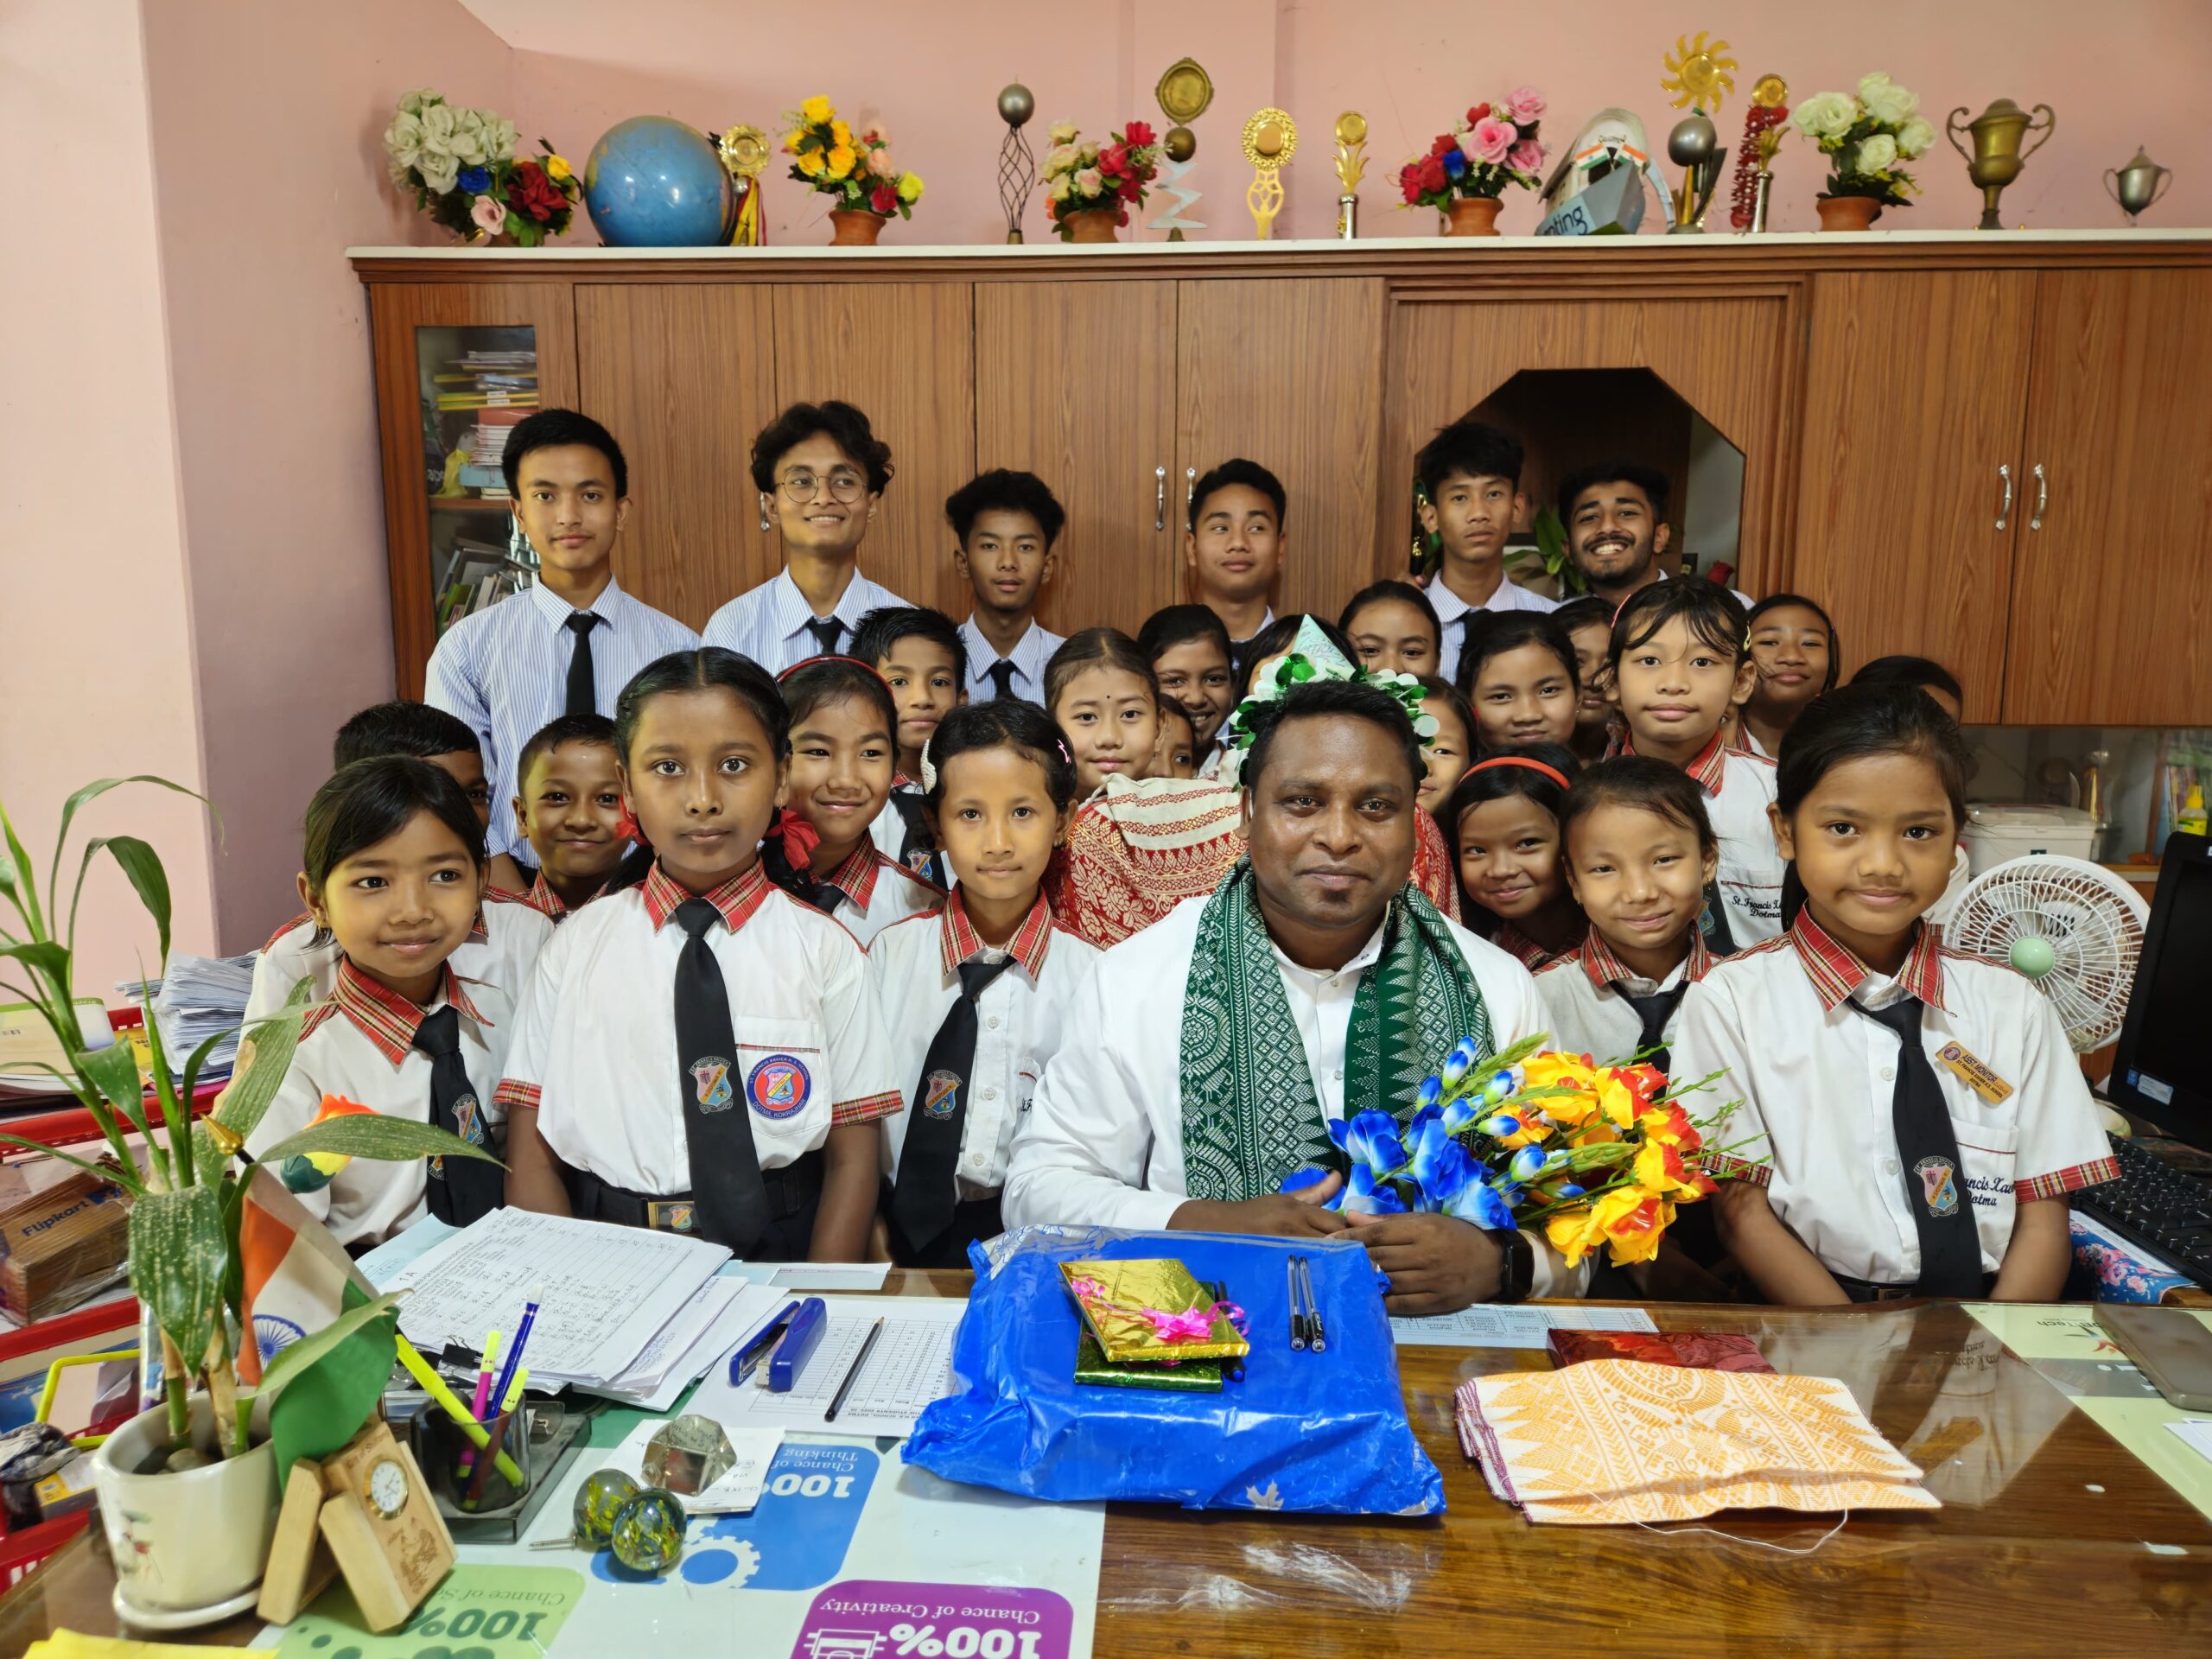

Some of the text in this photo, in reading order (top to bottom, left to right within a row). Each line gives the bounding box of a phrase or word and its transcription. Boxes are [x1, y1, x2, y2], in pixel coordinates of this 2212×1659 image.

[1745, 899, 1771, 910] Francis
[1750, 908, 1781, 918] Dotma
[751, 1059, 769, 1077] FRANCIS
[1974, 1064, 1997, 1083] MONITOR
[773, 1098, 806, 1118] KOKRAJHAR
[22, 1200, 90, 1236] Flipkart
[783, 1449, 858, 1462] Thinking
[771, 1460, 854, 1472] Chance of
[760, 1473, 855, 1498] 100
[458, 1587, 482, 1602] of
[487, 1590, 566, 1605] Chance
[820, 1598, 1040, 1624] Chance of Creativity
[889, 1623, 1042, 1659] 100%
